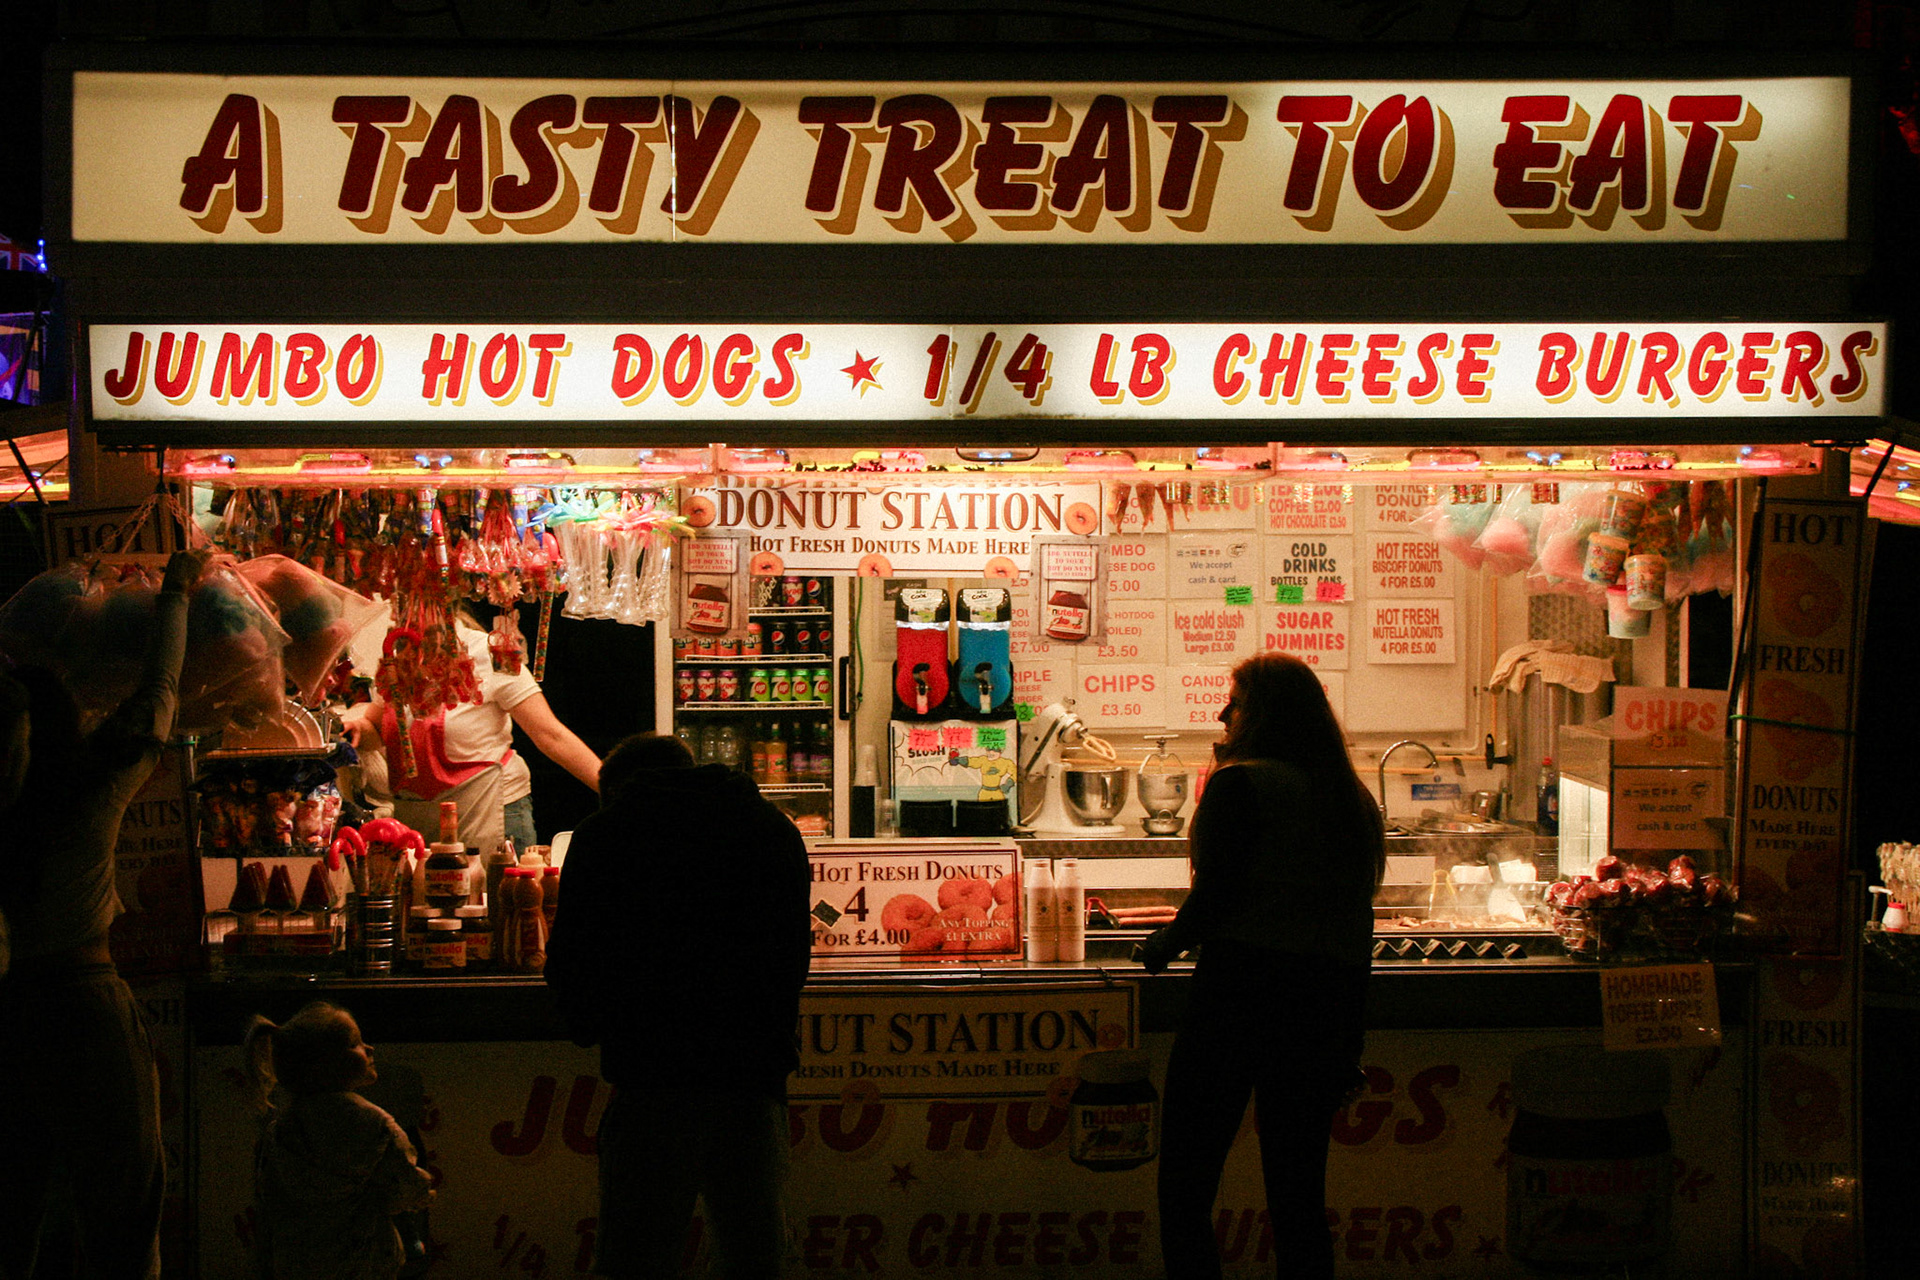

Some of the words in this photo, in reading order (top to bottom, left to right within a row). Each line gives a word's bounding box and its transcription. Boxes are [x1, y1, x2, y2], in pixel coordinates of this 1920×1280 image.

[183, 93, 283, 234] A
[331, 93, 760, 234] TASTY
[798, 93, 1248, 242] TREAT
[1276, 93, 1456, 232] TO
[1493, 93, 1763, 232] EAT
[104, 331, 384, 407] JUMBO
[421, 331, 573, 407] HOT
[610, 331, 811, 407] DOGS
[925, 330, 1053, 414] 1/4
[1089, 331, 1177, 407] LB
[1212, 331, 1501, 407] CHEESE
[1535, 329, 1880, 409] BURGERS
[716, 489, 867, 532] DONUT
[880, 489, 1066, 532] STATION
[1269, 498, 1309, 513] COFFEE
[1286, 515, 1327, 528] CHOCOLATE
[1772, 513, 1851, 545] HOT
[750, 536, 784, 554] HOT
[790, 536, 844, 554] FRESH
[853, 536, 919, 554] DONUTS
[928, 536, 978, 555] MADE
[985, 536, 1030, 556] HERE
[1111, 544, 1146, 556] MBO
[1291, 542, 1327, 558] COLD
[1376, 543, 1400, 559] HOT
[1402, 543, 1439, 559] FRESH
[1130, 562, 1156, 572] DOG
[1190, 561, 1203, 569] We
[1205, 561, 1232, 571] accept
[1283, 559, 1336, 574] DRINKS
[1372, 561, 1407, 573] BISCOFF
[1408, 561, 1443, 573] DONUTS
[1109, 580, 1140, 592] 5.00
[1188, 576, 1208, 584] cash
[1209, 576, 1216, 584] &
[1218, 576, 1236, 584] card
[1270, 576, 1309, 586] BOTTLES
[1380, 577, 1387, 588] 4
[1388, 577, 1408, 588] FOR
[1410, 577, 1435, 588] £5.00
[692, 601, 725, 612] nutella
[1052, 607, 1084, 618] nutella
[1114, 611, 1156, 619] HOTDOG
[1174, 611, 1190, 630] Ice
[1192, 610, 1215, 630] cold
[1217, 610, 1245, 630] slush
[1276, 611, 1334, 630] SUGAR
[1376, 609, 1400, 625] HOT
[1402, 609, 1440, 625] FRESH
[1107, 626, 1143, 637] OILED)
[1215, 630, 1236, 642] £2.50
[1372, 626, 1409, 639] NUTELLA
[1410, 626, 1444, 639] DONUTS
[1184, 643, 1210, 654] Large
[1211, 643, 1235, 652] £3.00
[1266, 633, 1345, 651] DUMMIES
[1380, 642, 1387, 654] 4
[1387, 642, 1408, 654] FOR
[1410, 642, 1436, 654] £5.00
[1097, 645, 1139, 657] £3.50
[1759, 645, 1845, 673] FRESH
[1013, 669, 1052, 683] RIPLE
[1084, 674, 1156, 693] CHIPS
[1013, 695, 1043, 703] URGER
[1185, 693, 1231, 704] FLOSS
[1101, 704, 1141, 716] £3.50
[1624, 699, 1717, 731] CHIPS
[1754, 785, 1839, 813] DONUTS
[1639, 803, 1656, 812] We
[1659, 803, 1692, 814] accept
[1637, 820, 1660, 831] cash
[1663, 821, 1671, 831] &
[1674, 820, 1697, 831] card
[1750, 819, 1792, 834] MADE
[1797, 820, 1836, 836] HERE
[810, 862, 852, 882] HOT
[858, 861, 919, 881] FRESH
[926, 860, 1003, 881] DONUTS
[844, 886, 869, 922] 4
[938, 917, 962, 929] ANY
[963, 917, 1010, 930] TOPPING
[812, 929, 850, 947] FOR
[855, 928, 910, 946] £4.00
[961, 931, 1002, 942] EXTRA
[1606, 971, 1703, 998] HOMEMADE
[888, 1010, 1100, 1053] STATION
[1763, 1019, 1847, 1047] FRESH
[796, 1063, 845, 1078] RESH
[851, 1061, 931, 1079] DONUTS
[937, 1060, 998, 1078] MADE
[1004, 1058, 1060, 1076] HERE
[1082, 1104, 1150, 1128] nutella
[908, 1211, 1147, 1268] CHEESE
